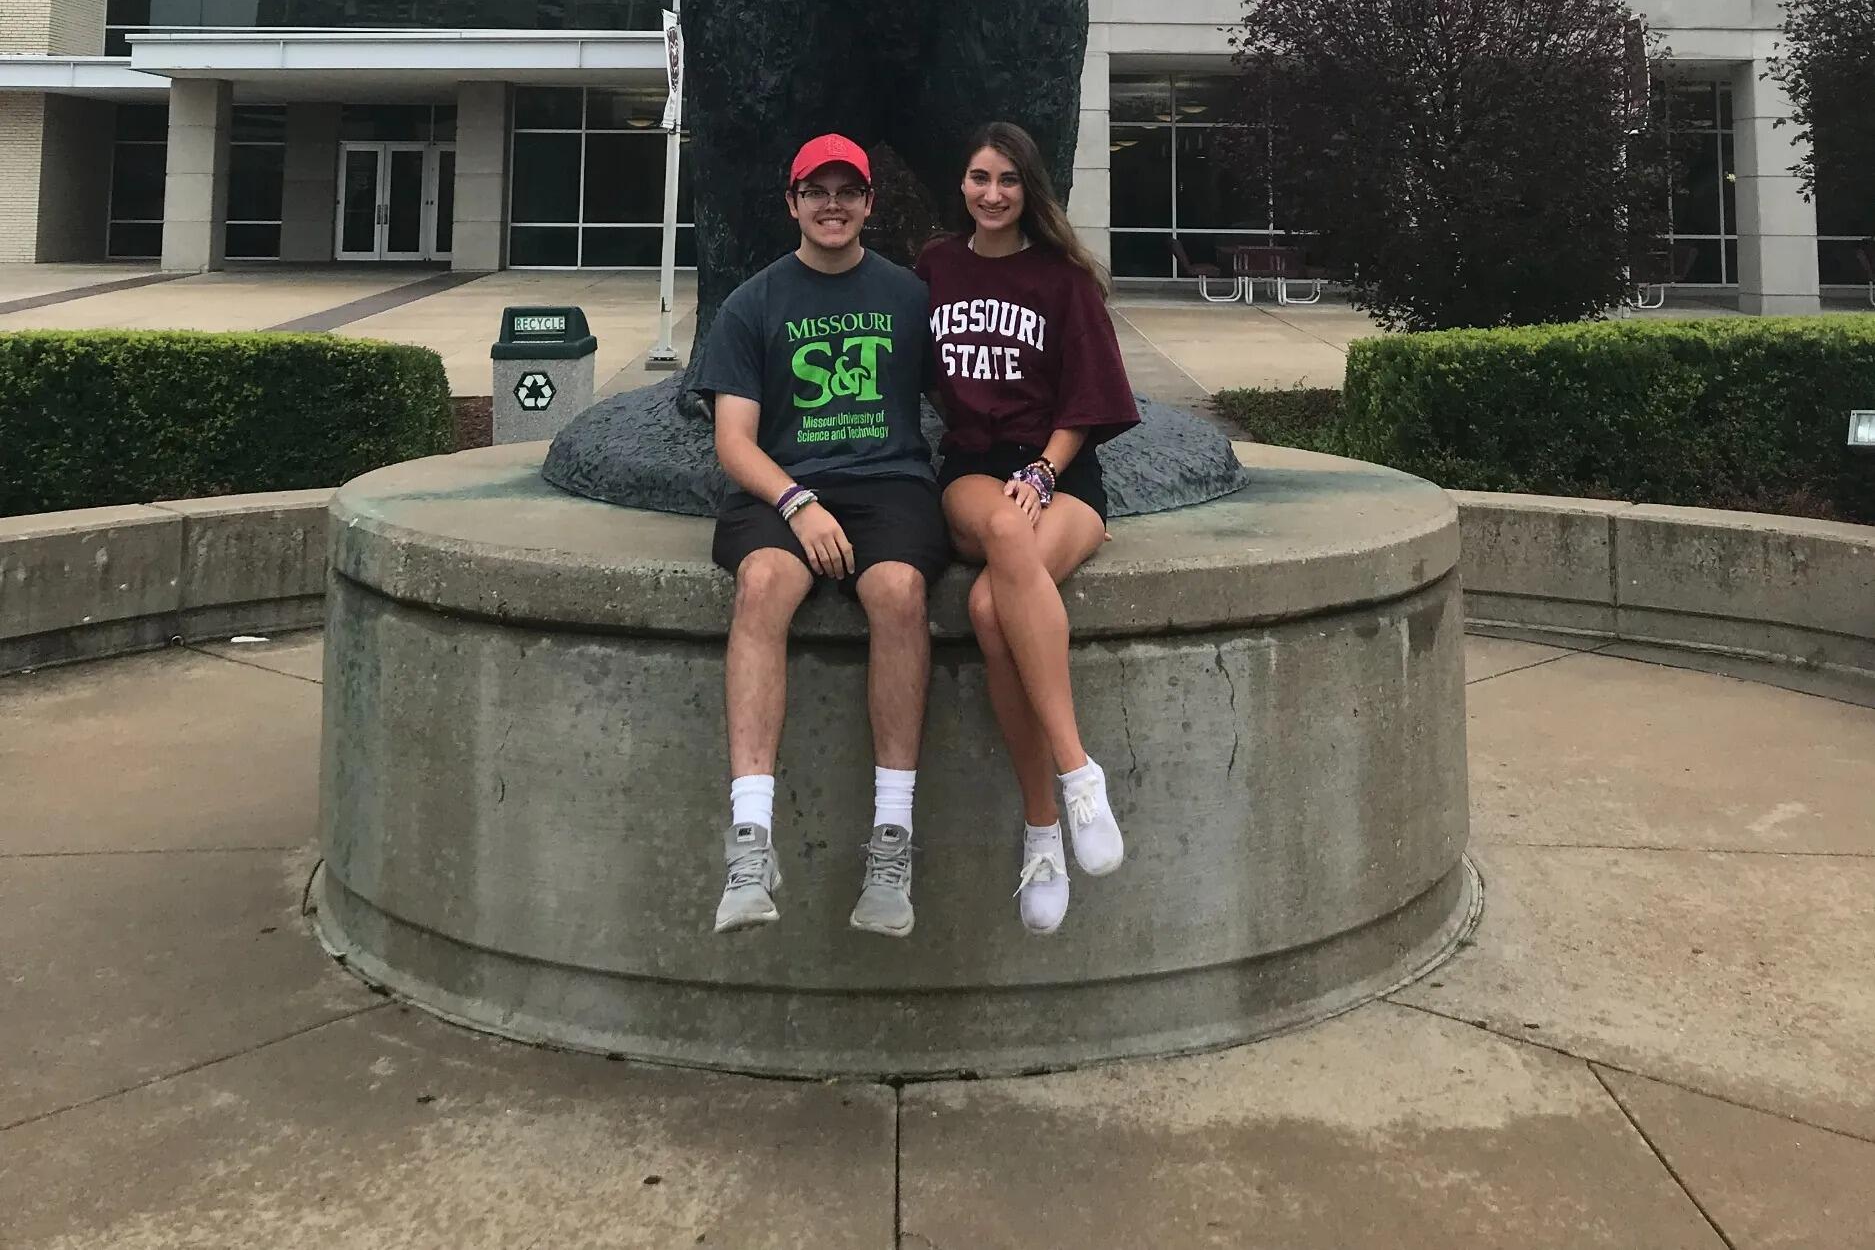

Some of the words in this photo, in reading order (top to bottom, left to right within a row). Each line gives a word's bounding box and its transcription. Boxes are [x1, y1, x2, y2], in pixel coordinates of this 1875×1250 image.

[516, 318, 564, 330] RECYCLE
[786, 312, 893, 342] MISSOURI
[791, 336, 893, 408] S&T
[941, 343, 1022, 380] STATE
[838, 412, 875, 426] University
[876, 409, 885, 423] of
[797, 429, 830, 443] Science
[831, 427, 847, 441] and
